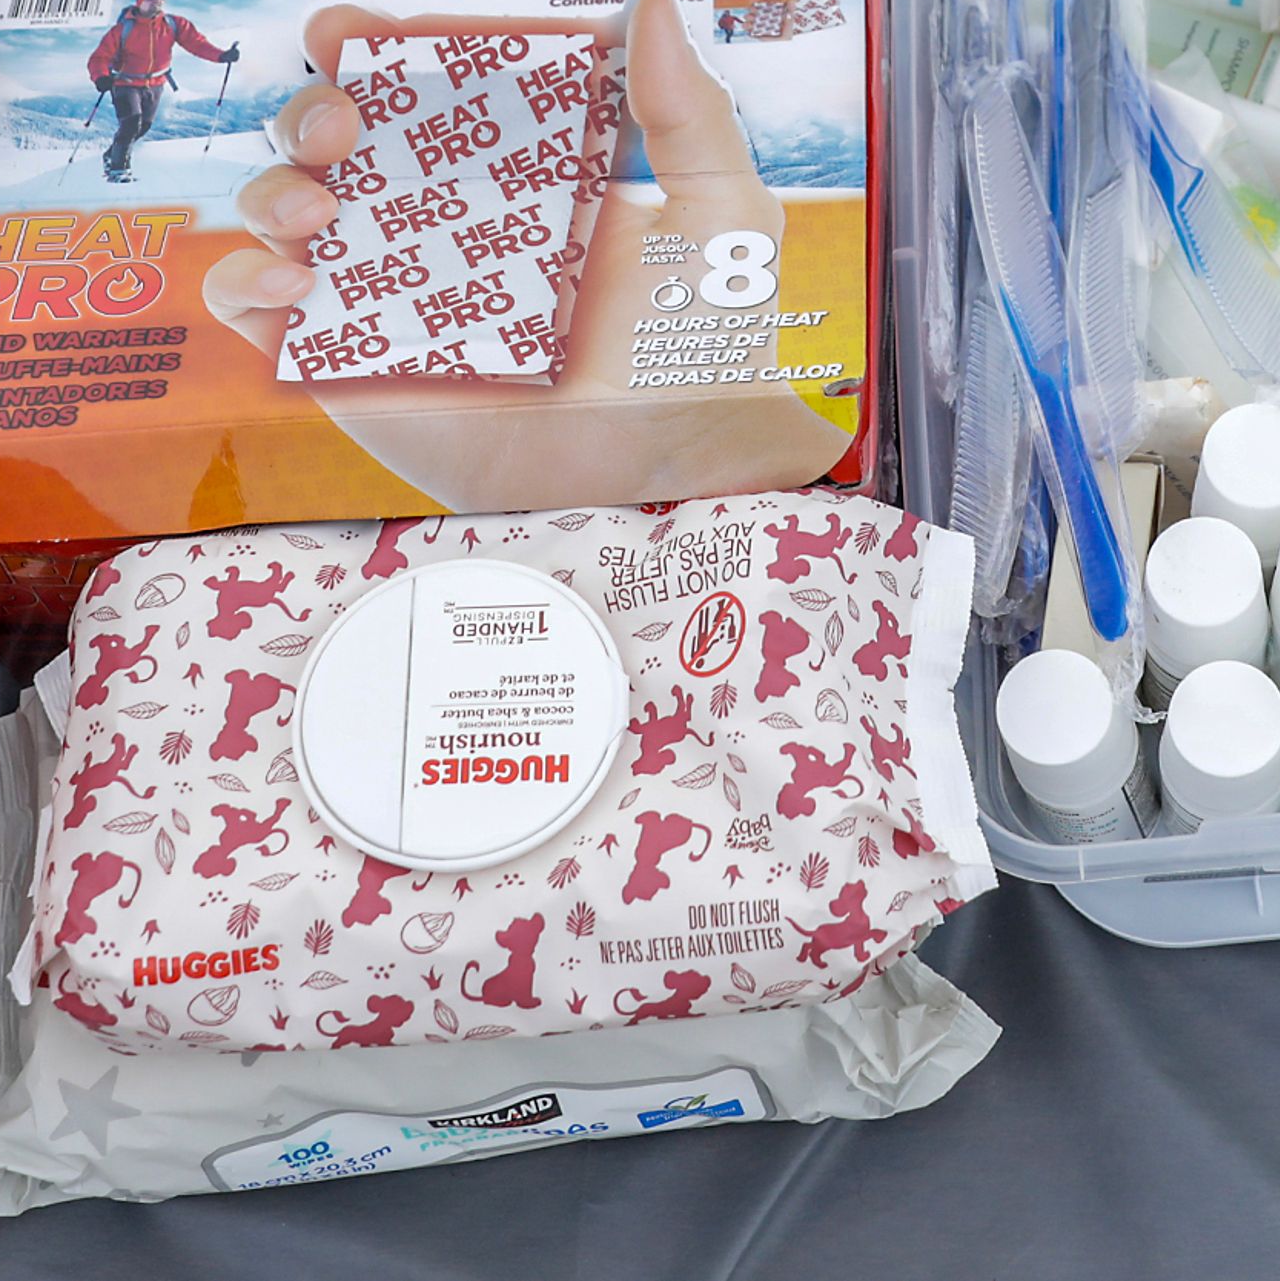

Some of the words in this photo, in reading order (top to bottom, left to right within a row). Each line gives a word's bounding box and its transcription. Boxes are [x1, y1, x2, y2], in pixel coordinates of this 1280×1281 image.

[516, 43, 596, 98] HEAT
[403, 92, 490, 150] HEAT
[641, 254, 686, 265] HASTA
[699, 229, 778, 309] 8
[634, 316, 721, 335] HOURS
[724, 314, 760, 330] OF
[762, 311, 828, 328] HEAT
[34, 327, 188, 352] WARMERS
[631, 334, 730, 353] HEURES
[733, 333, 770, 347] DE
[631, 350, 749, 369] CHALEUR
[628, 370, 717, 388] HORAS
[721, 368, 755, 383] DE
[759, 363, 844, 381] CALOR
[711, 520, 757, 544] AUX
[680, 542, 718, 570] PAS
[722, 537, 752, 560] NE
[722, 558, 751, 582] DO
[676, 565, 718, 599] NOT
[603, 578, 669, 614] FLUSH
[453, 611, 535, 623] DISPENSING
[452, 621, 534, 638] HANDED
[500, 675, 539, 687] karité
[543, 674, 558, 685] de
[449, 689, 488, 700] cacao
[491, 688, 507, 700] de
[510, 687, 555, 699] beurre
[558, 687, 574, 699] de
[441, 708, 485, 720] butter
[487, 708, 518, 719] shea
[522, 707, 531, 718] &
[534, 705, 574, 716] cocoa
[439, 732, 542, 755] nourish
[421, 754, 570, 785] HUGGIES
[689, 905, 707, 930] DO
[710, 902, 737, 928] NOT
[739, 899, 781, 925] FLUSH
[600, 941, 616, 964] NE
[618, 939, 645, 963] PAS
[646, 936, 684, 961] JETER
[688, 934, 717, 959] AUX
[719, 927, 784, 957] TOILETTES
[133, 943, 280, 987] HUGGIES
[278, 1141, 330, 1163] 100
